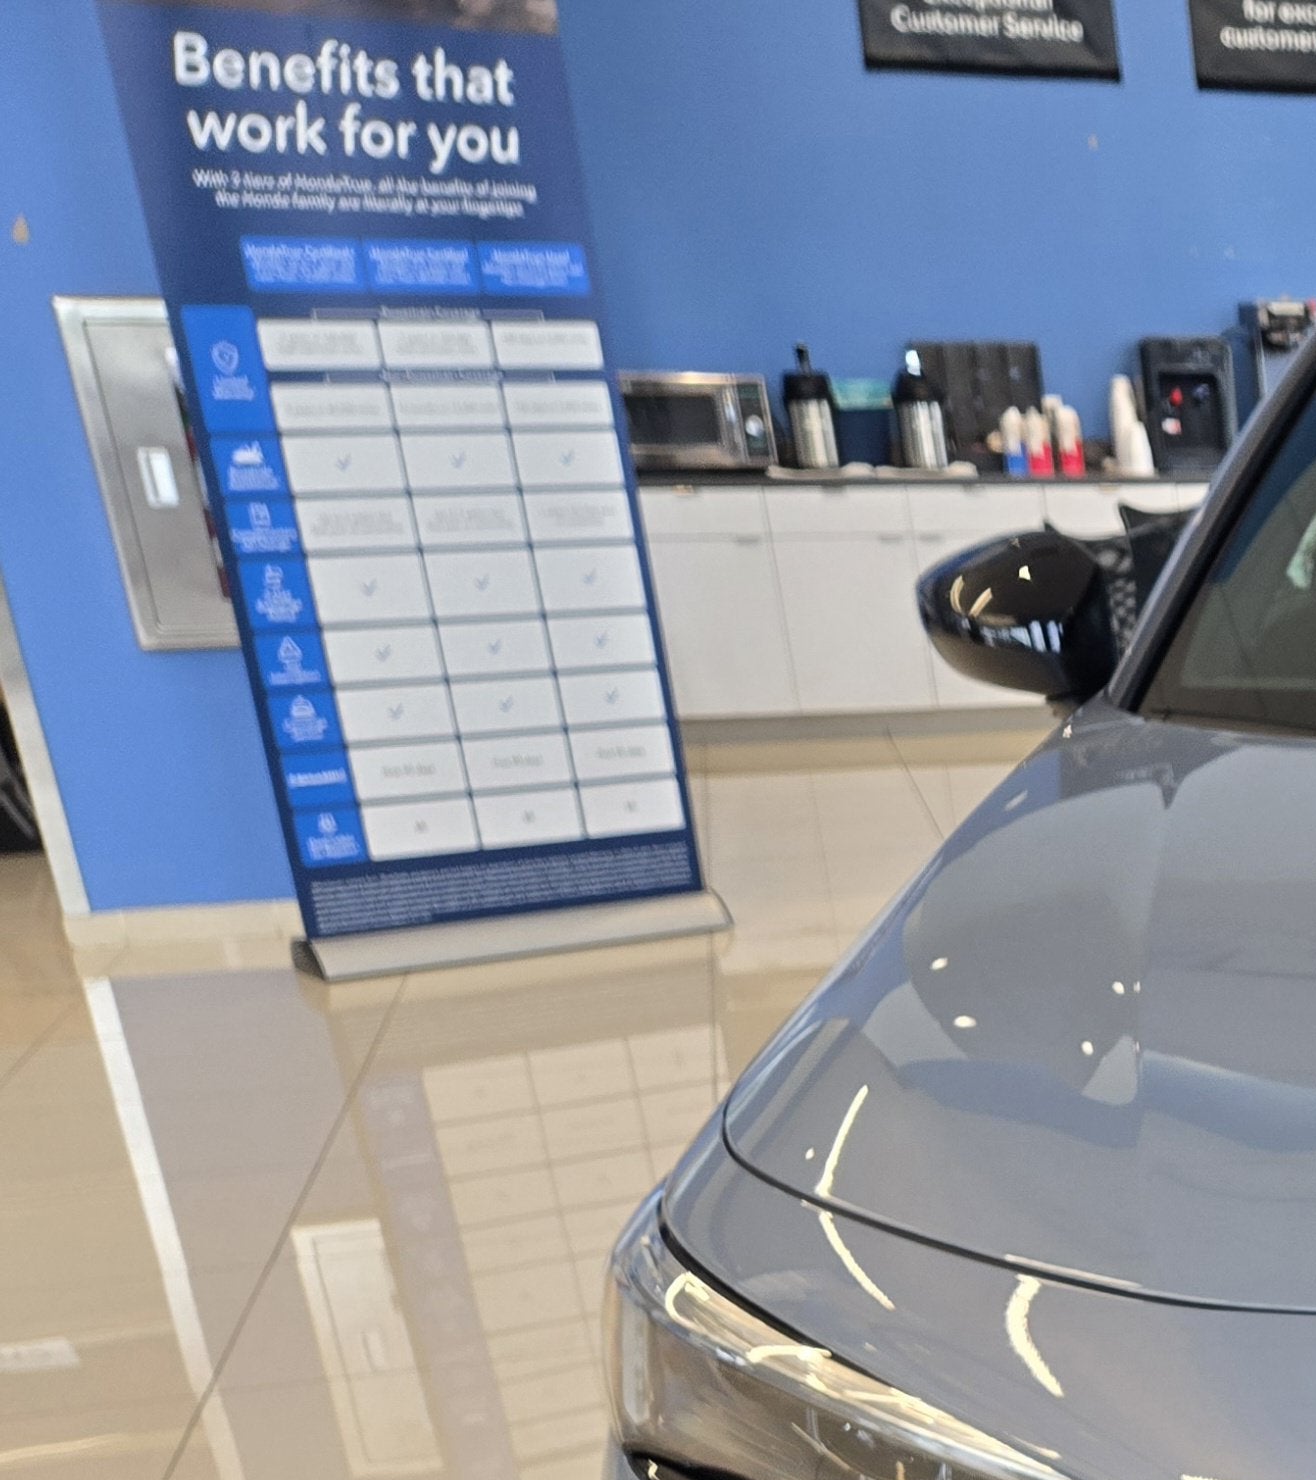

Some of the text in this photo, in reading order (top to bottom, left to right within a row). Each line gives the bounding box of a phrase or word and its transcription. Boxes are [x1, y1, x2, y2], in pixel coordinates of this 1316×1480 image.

[890, 4, 1084, 42] Customer Service
[1242, 0, 1276, 23] for
[173, 30, 515, 107] Benefits that
[187, 99, 521, 174] work for you
